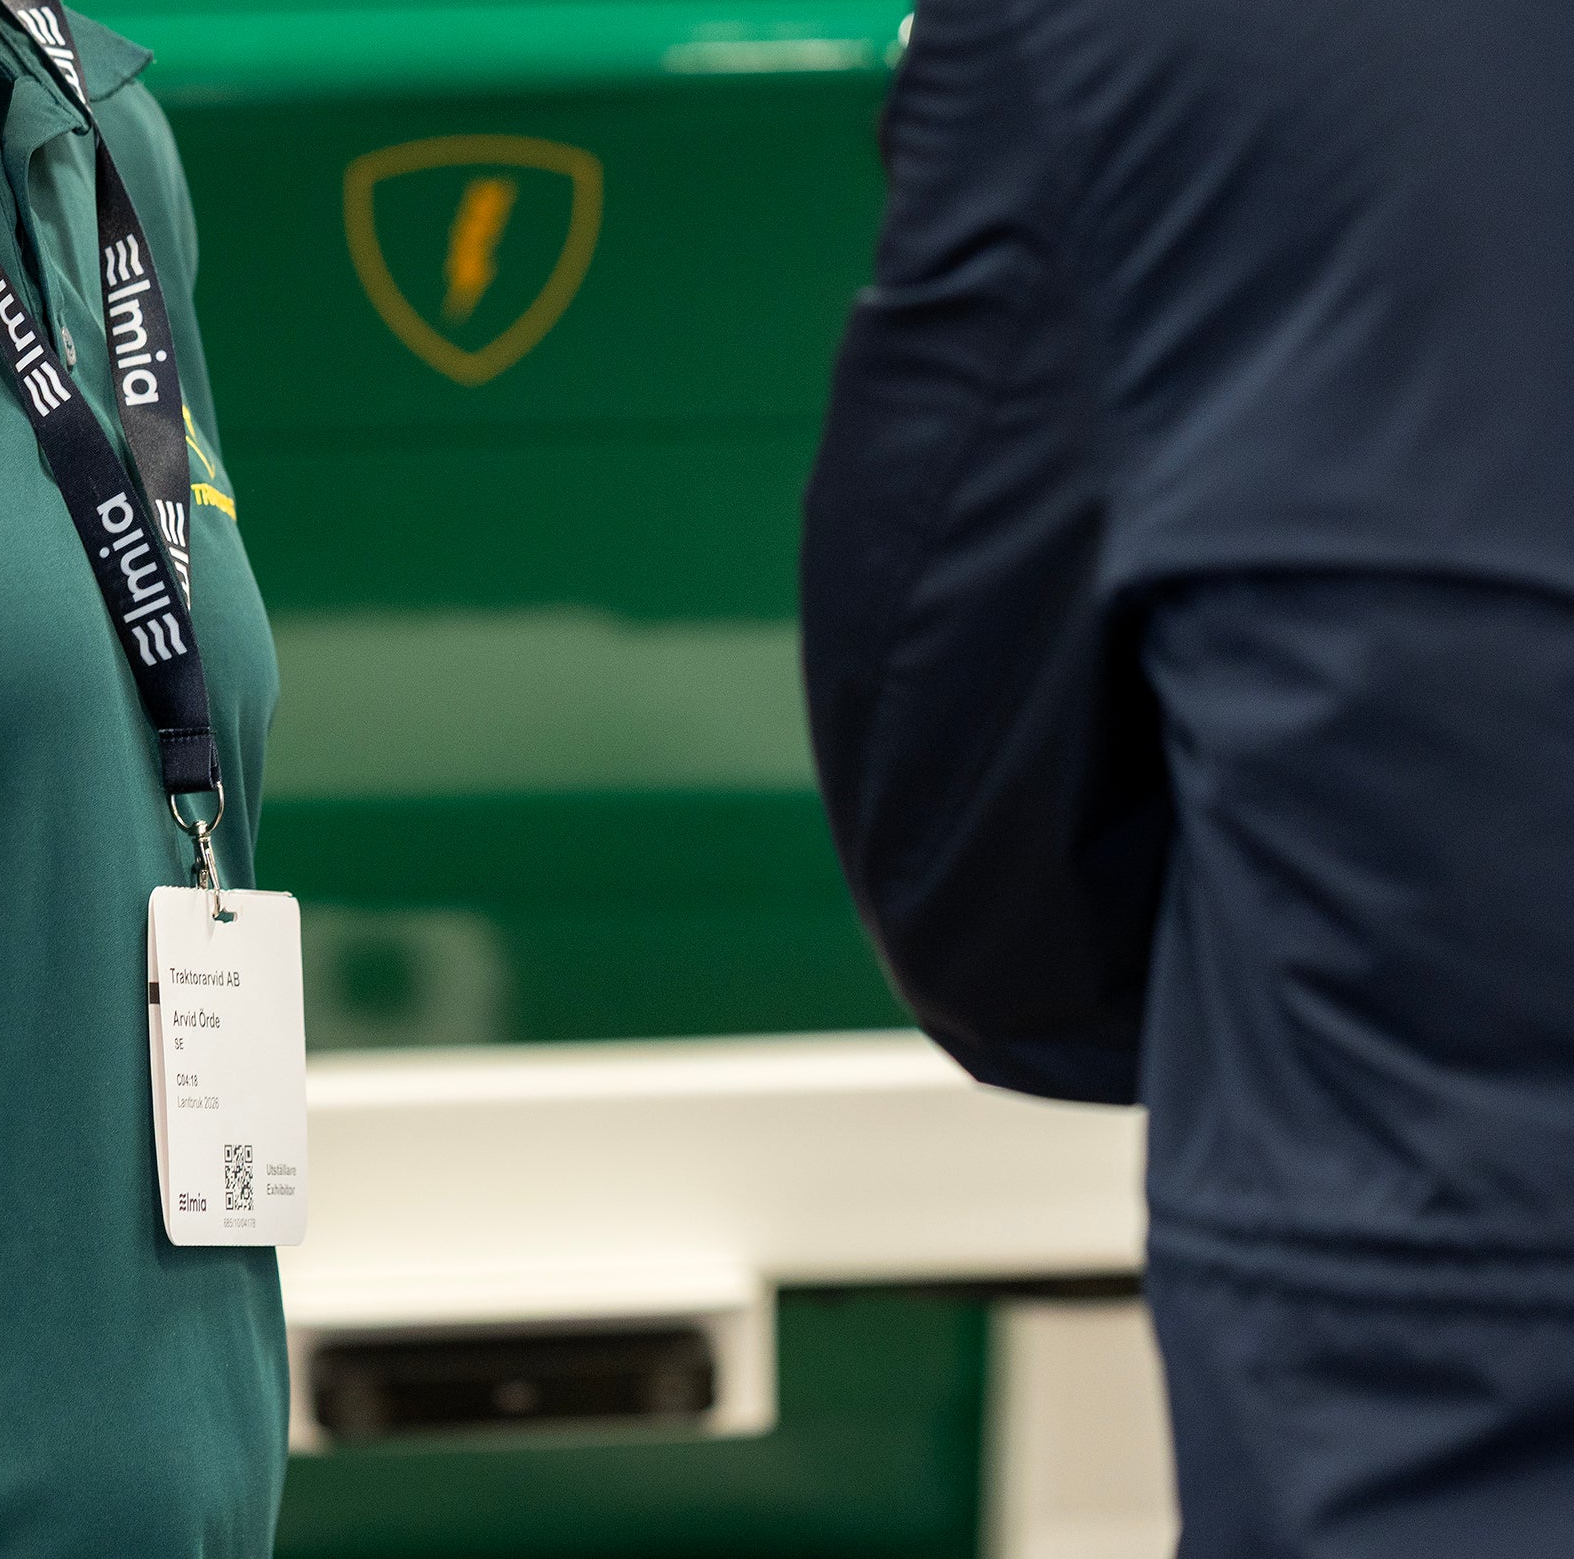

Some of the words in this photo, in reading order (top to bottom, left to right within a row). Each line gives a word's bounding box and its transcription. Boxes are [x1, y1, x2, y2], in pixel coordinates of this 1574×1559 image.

[106, 234, 167, 407] Elmia
[97, 491, 188, 666] Elmia
[169, 967, 224, 987] Traktorarvid
[226, 971, 241, 988] AB
[173, 1010, 197, 1028] Arvid
[198, 1008, 221, 1029] Örde
[175, 1038, 184, 1050] SE
[266, 1182, 296, 1197] Exhibitor
[179, 1192, 207, 1213] Elmia
